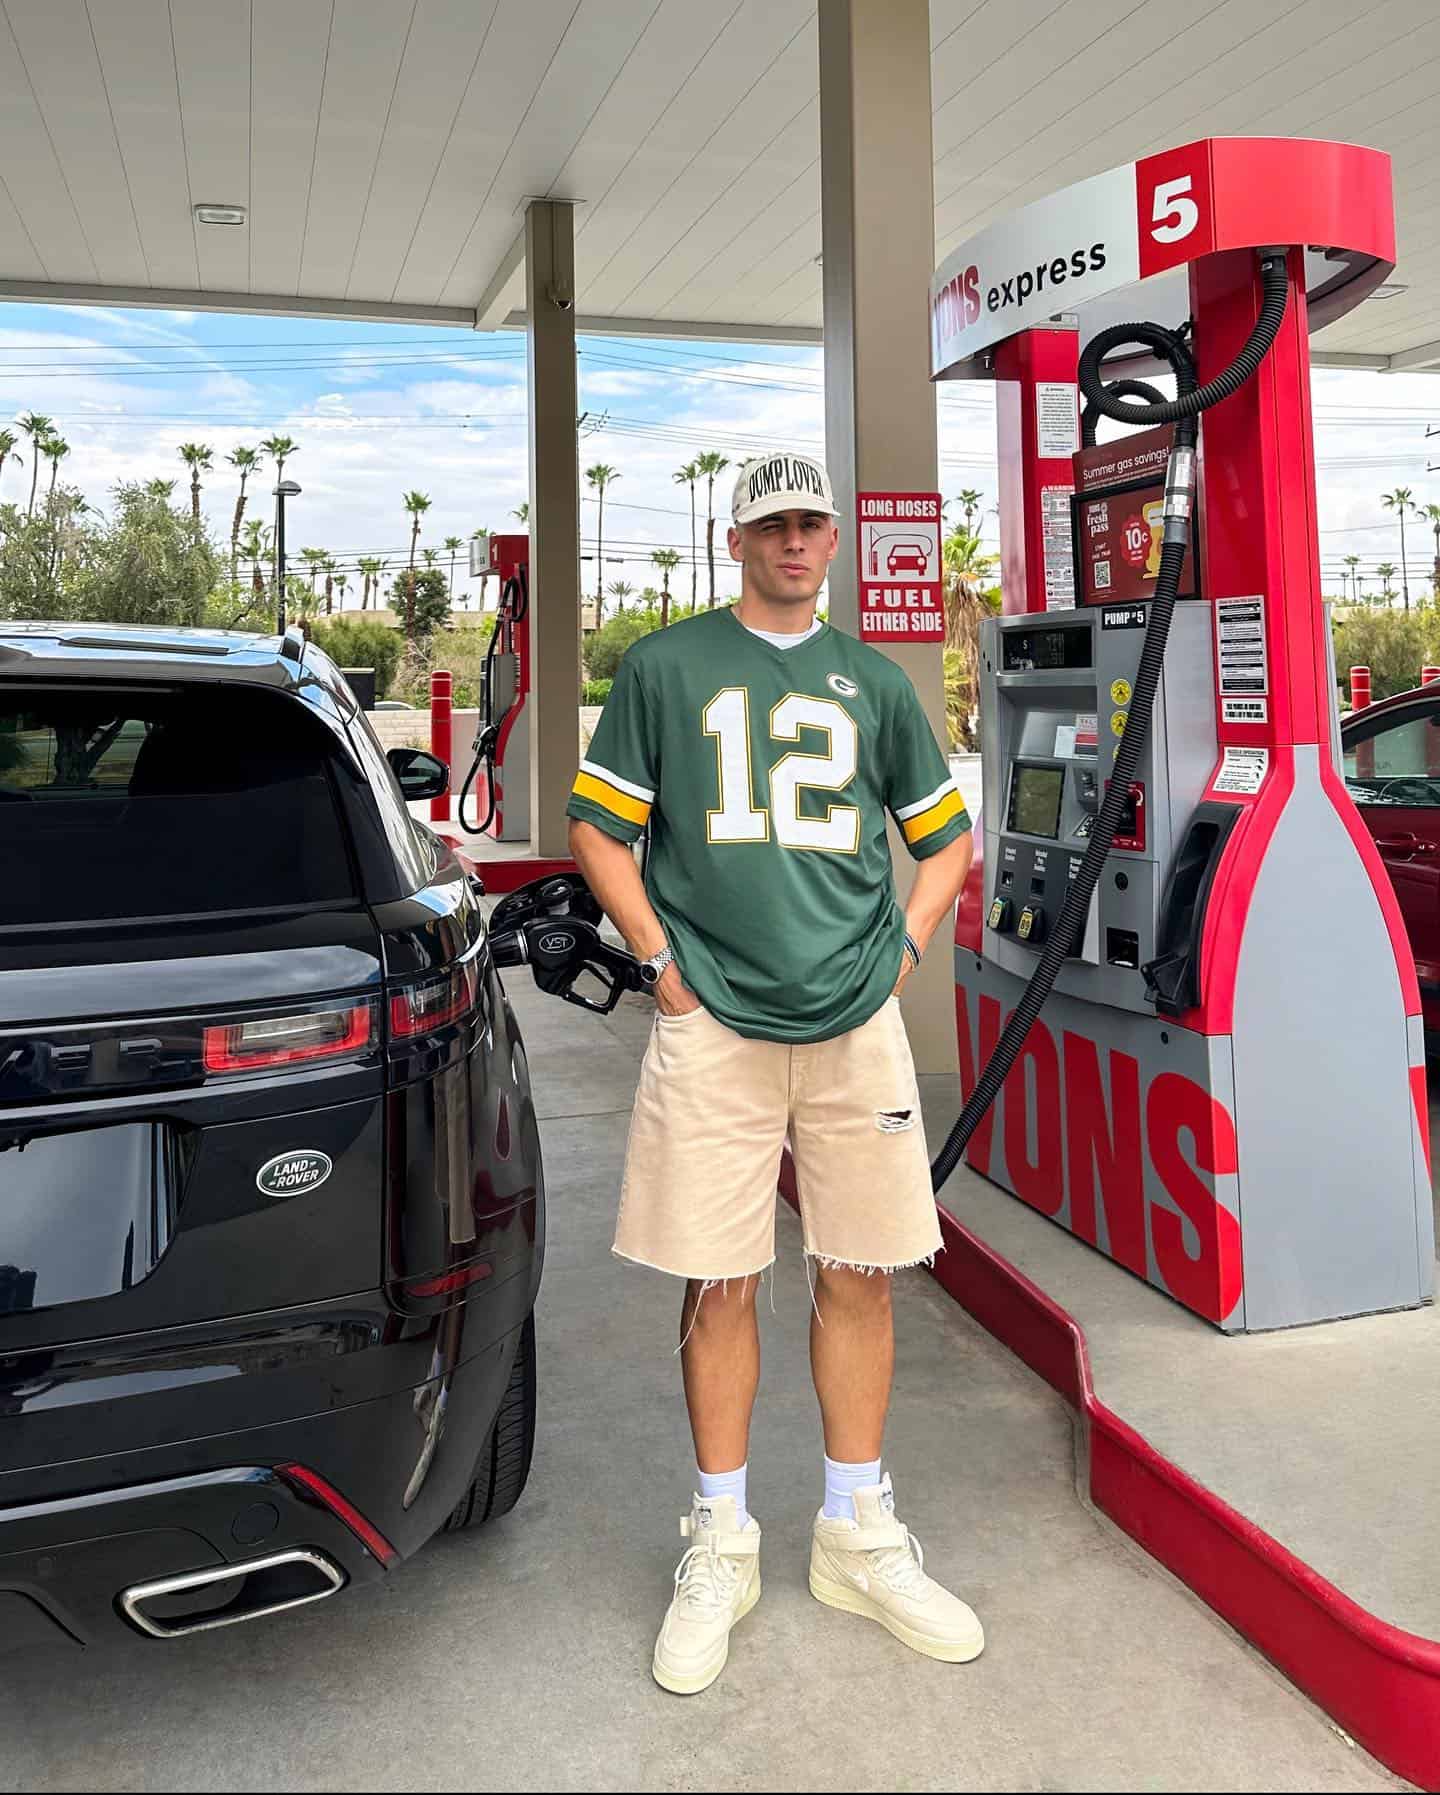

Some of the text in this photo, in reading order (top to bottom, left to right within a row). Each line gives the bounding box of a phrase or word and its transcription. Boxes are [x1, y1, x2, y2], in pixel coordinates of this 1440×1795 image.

[1150, 174, 1199, 245] 5
[987, 242, 1107, 313] express
[1083, 446, 1170, 480] Summer gas savings!
[861, 499, 937, 517] LONG HOSES
[867, 588, 936, 608] FUEL
[862, 611, 943, 632] EITHER SIDE
[1104, 612, 1130, 625] PUMP
[701, 686, 862, 856] 12
[955, 983, 1243, 1323] VONS
